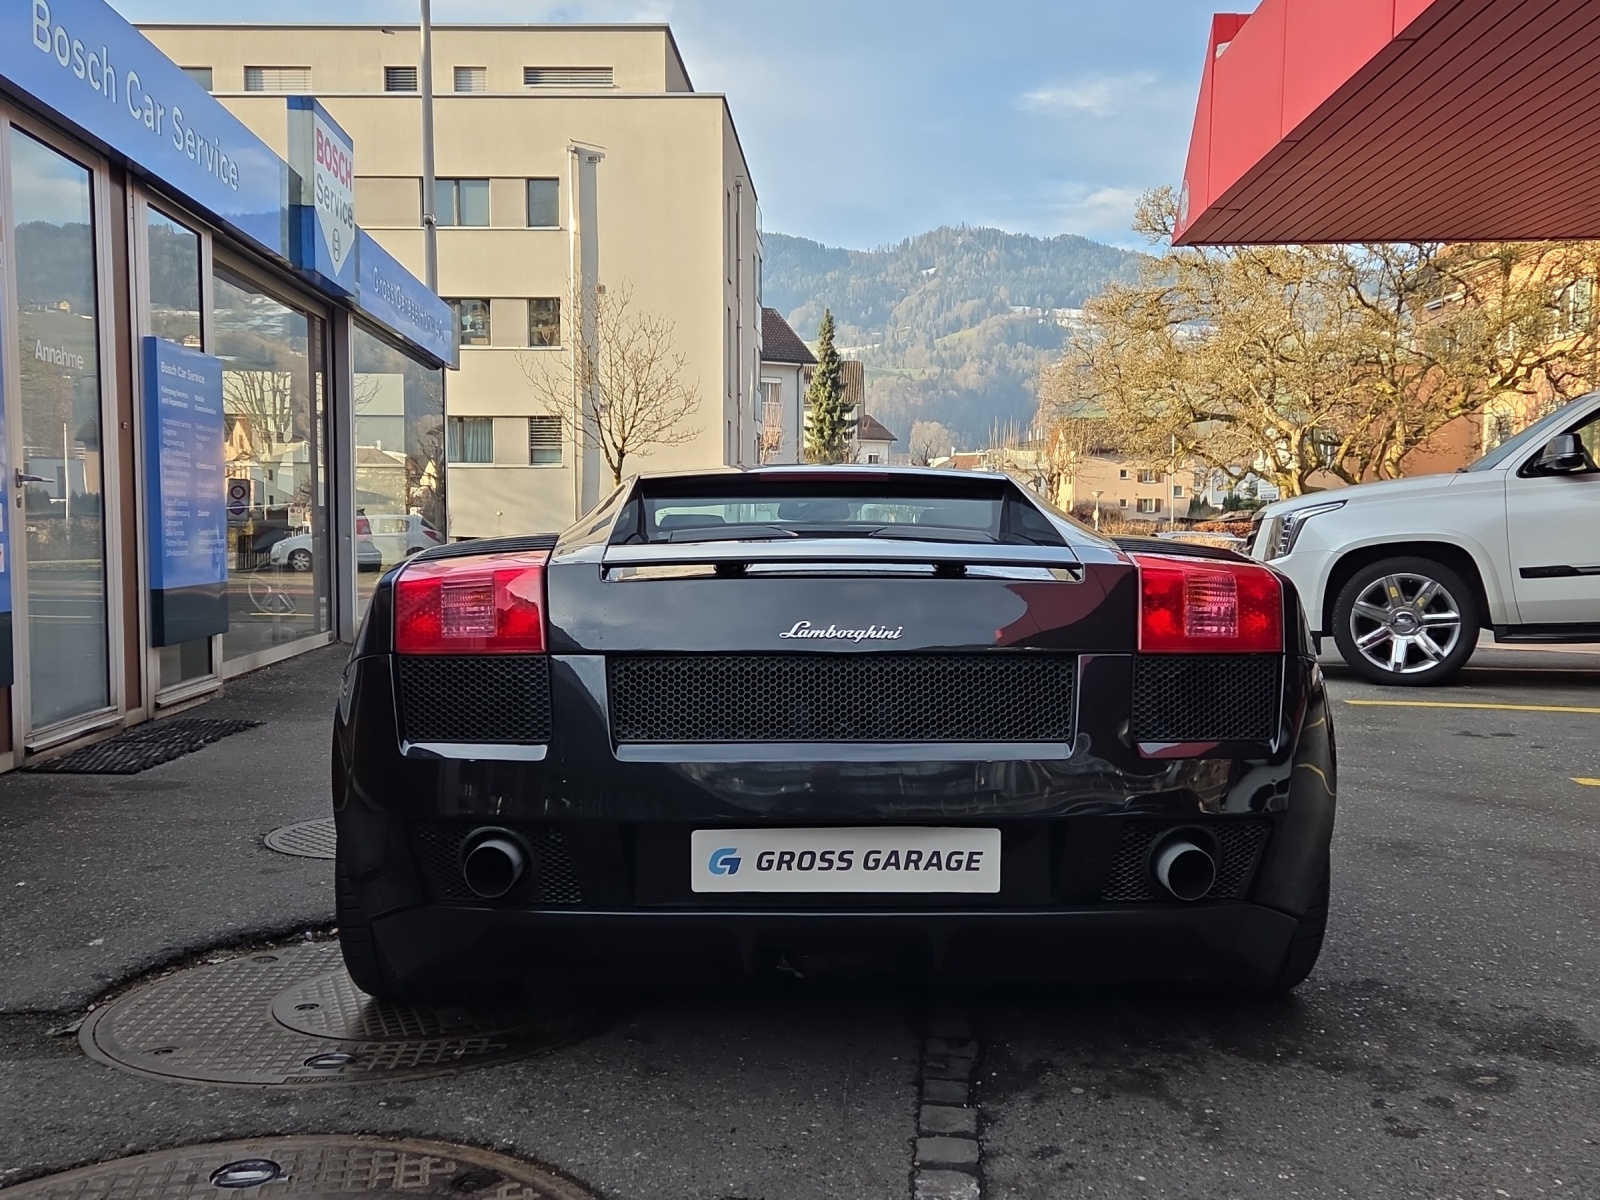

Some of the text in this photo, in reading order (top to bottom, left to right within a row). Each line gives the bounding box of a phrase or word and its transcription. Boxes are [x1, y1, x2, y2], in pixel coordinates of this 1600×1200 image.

[33, 0, 239, 191] Bosch Car Service
[316, 127, 352, 192] BOSCH
[316, 173, 353, 230] Service
[373, 266, 395, 305] Gross
[34, 339, 84, 370] Annahme
[160, 360, 205, 384] Bosch Car Service
[779, 620, 903, 643] Lamborghini
[756, 850, 854, 871] GROSS
[862, 850, 984, 871] GARAGE
